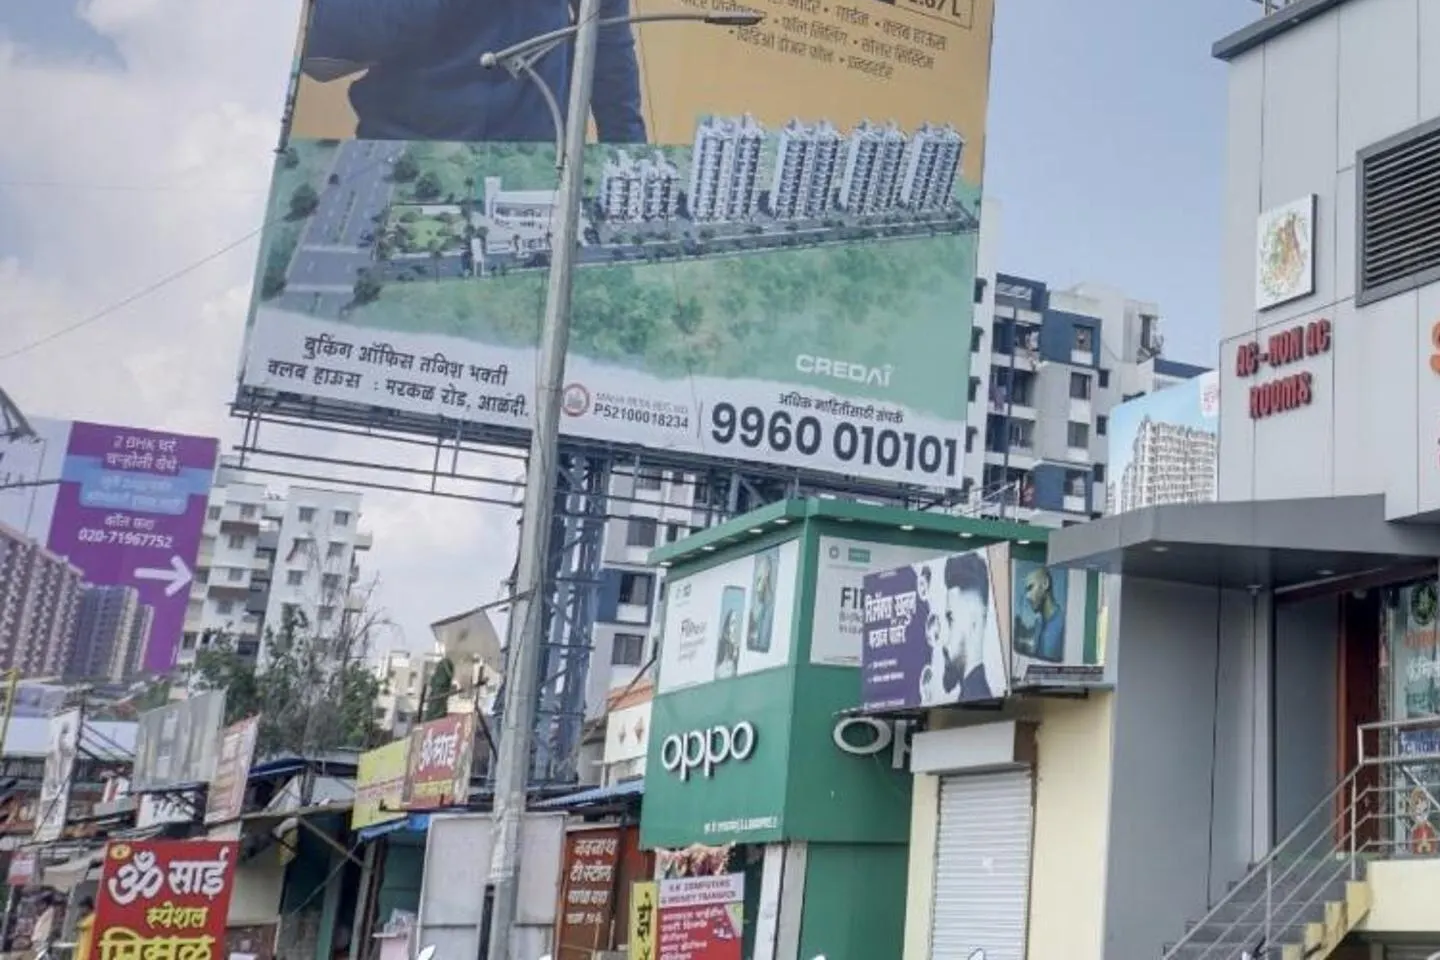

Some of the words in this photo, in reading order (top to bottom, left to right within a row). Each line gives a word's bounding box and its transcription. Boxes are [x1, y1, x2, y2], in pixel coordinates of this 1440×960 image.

[795, 353, 893, 388] CREDAI
[711, 402, 822, 456] 9960
[833, 421, 957, 477] 010101
[662, 721, 755, 781] oppo
[168, 846, 230, 900] साई
